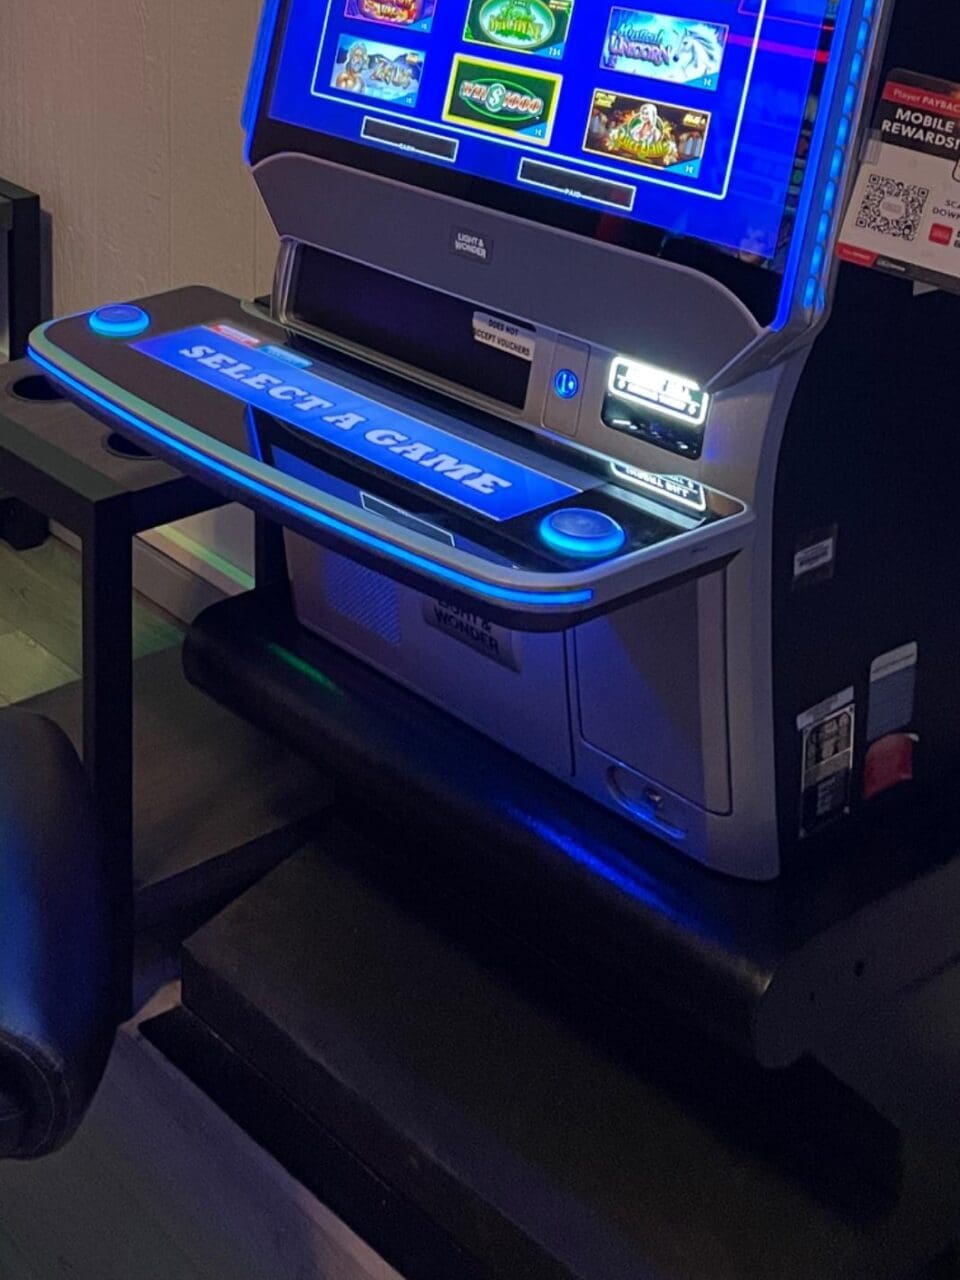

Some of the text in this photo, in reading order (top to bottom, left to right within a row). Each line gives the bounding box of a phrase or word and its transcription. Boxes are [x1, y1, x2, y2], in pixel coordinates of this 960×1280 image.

[608, 32, 672, 67] UNICORN
[893, 87, 921, 102] Player
[895, 107, 956, 134] MOBILE
[881, 119, 960, 151] REWARDS!
[564, 187, 582, 199] PAID
[456, 231, 478, 247] LIGHT
[454, 240, 487, 260] WONDER
[488, 318, 519, 336] DOES NOT
[497, 337, 530, 356] VOUCHERS
[179, 342, 514, 495] SELECT A GAME
[433, 604, 500, 656] WONDER
